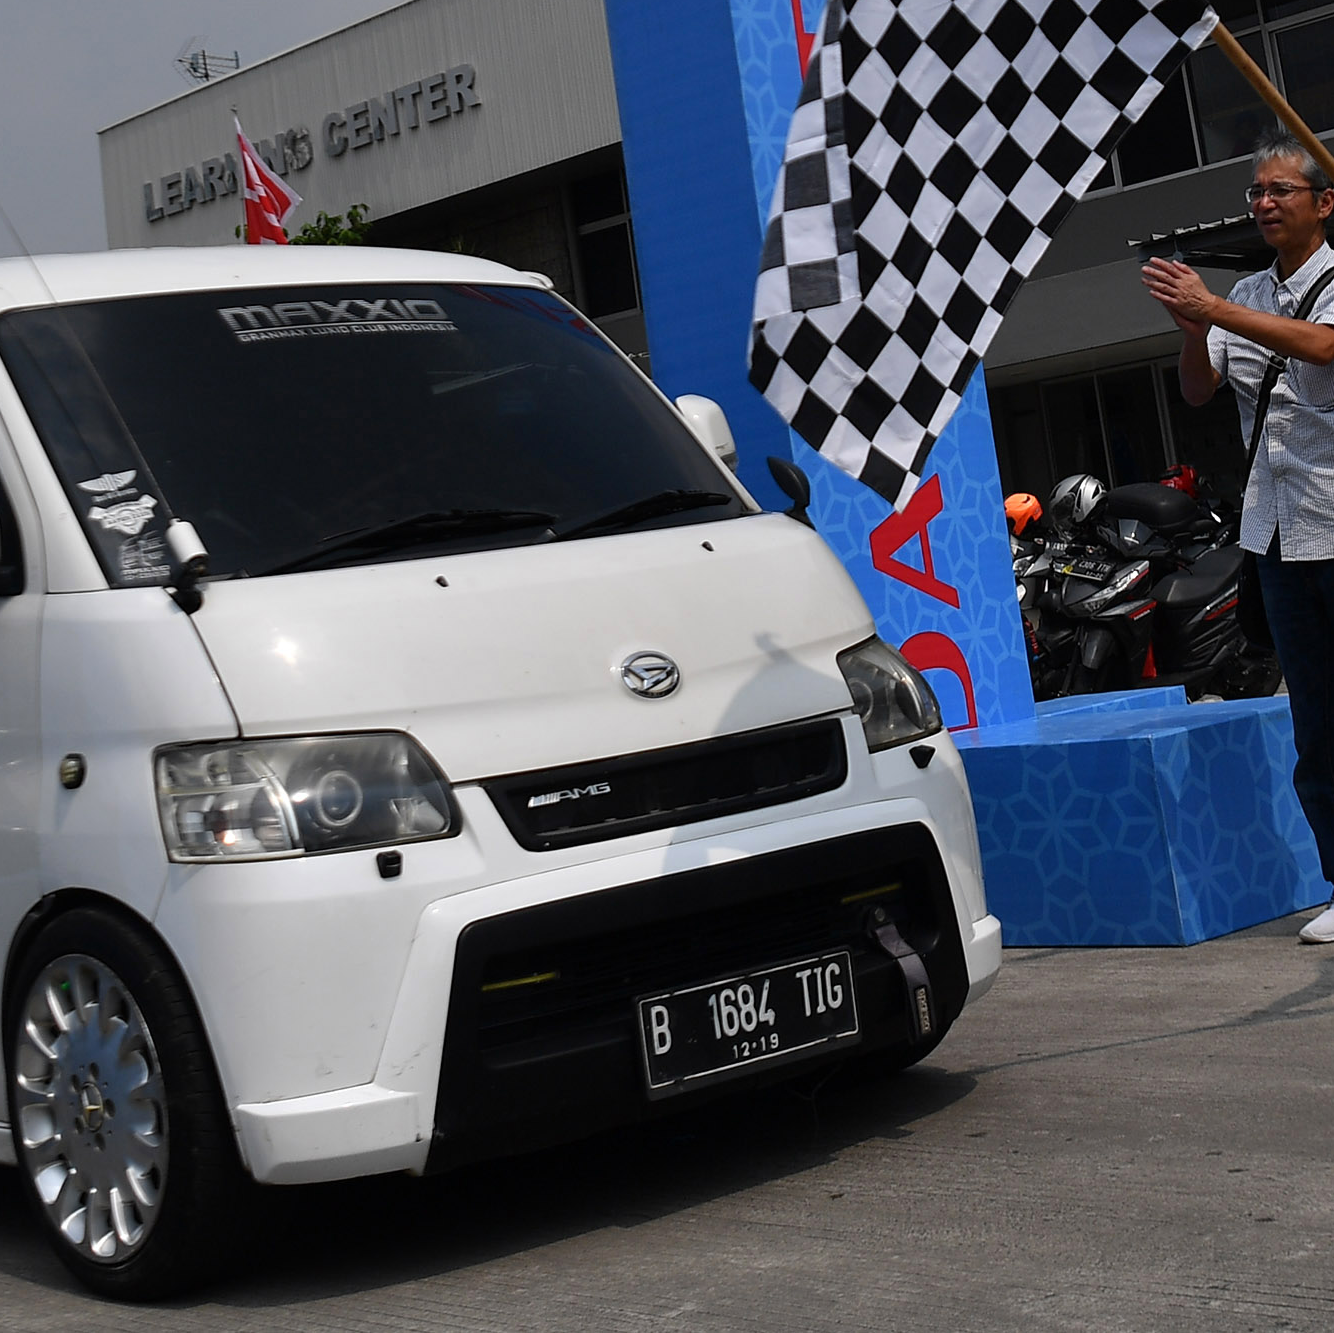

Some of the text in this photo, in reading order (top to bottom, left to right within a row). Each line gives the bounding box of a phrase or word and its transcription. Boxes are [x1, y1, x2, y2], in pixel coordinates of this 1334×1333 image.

[322, 63, 482, 159] CENTER
[558, 782, 611, 802] AMG
[651, 962, 844, 1056] B 1684 TIG
